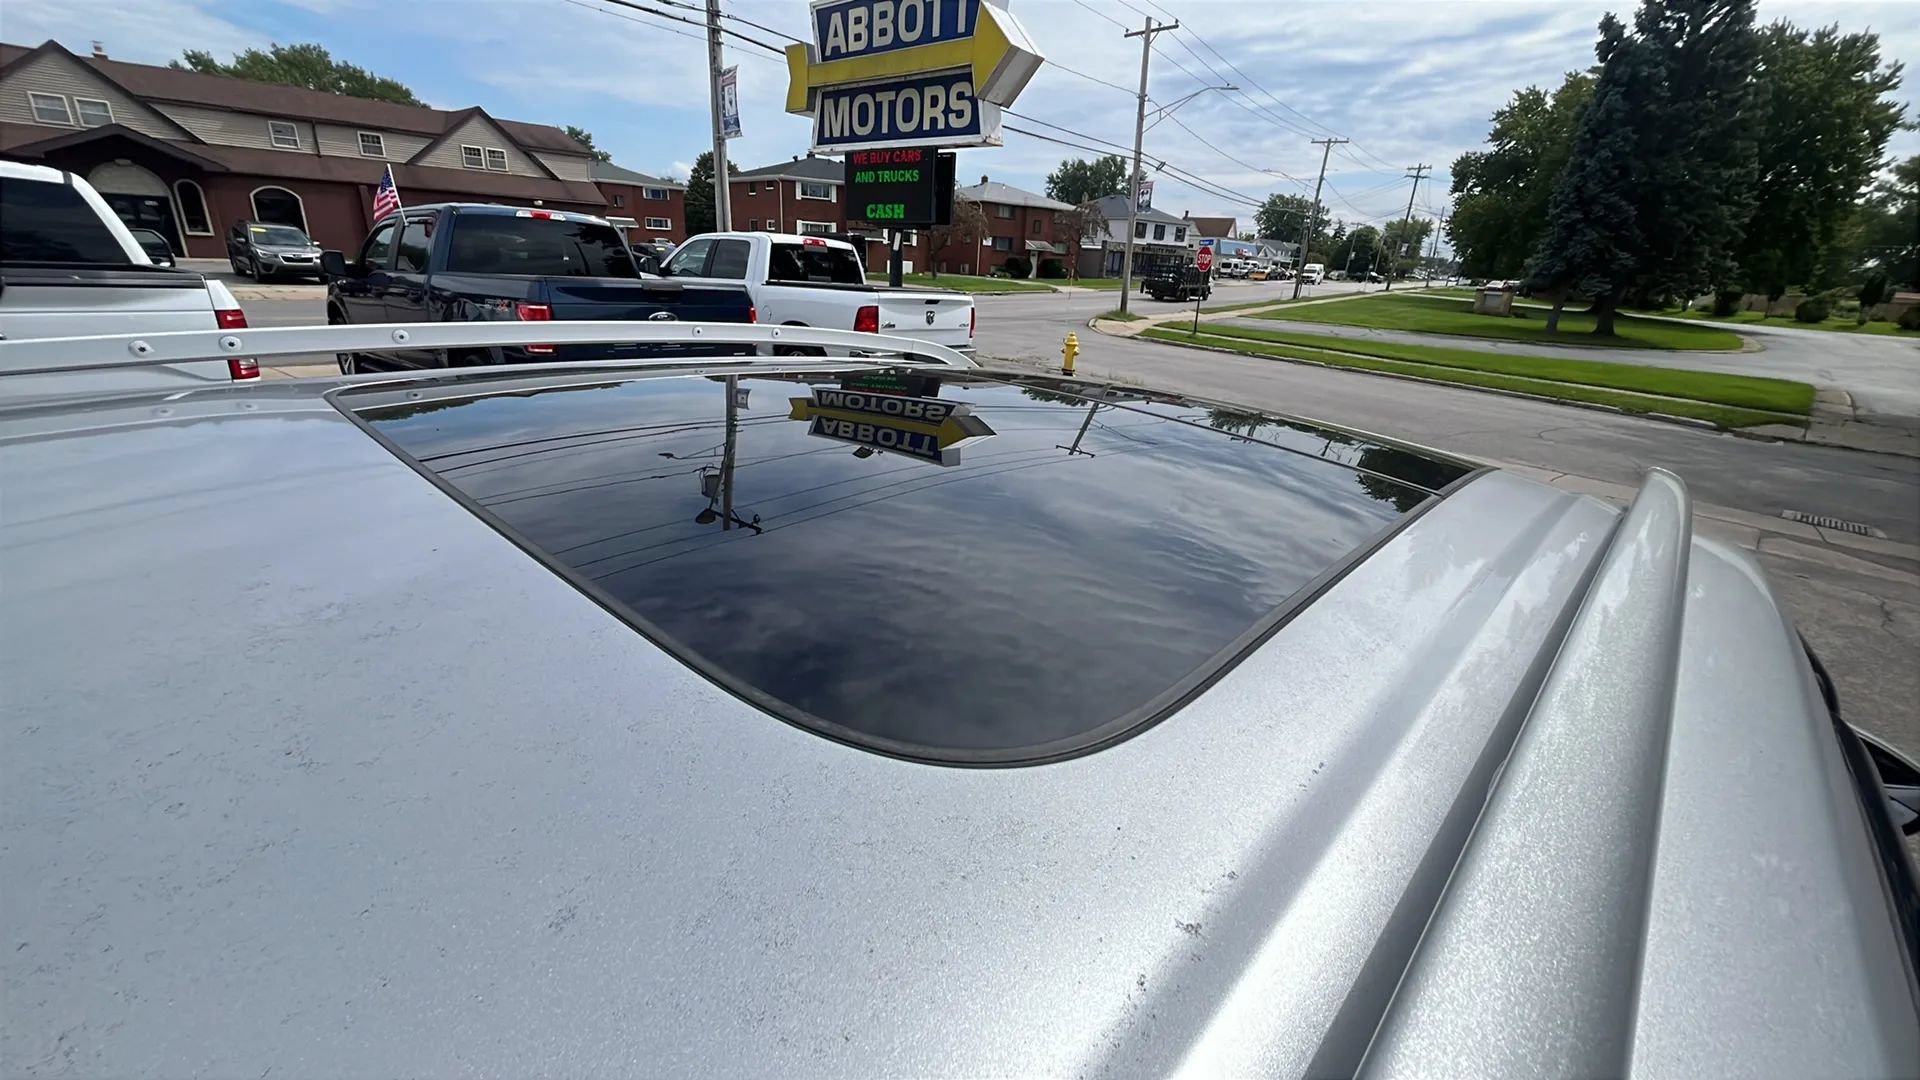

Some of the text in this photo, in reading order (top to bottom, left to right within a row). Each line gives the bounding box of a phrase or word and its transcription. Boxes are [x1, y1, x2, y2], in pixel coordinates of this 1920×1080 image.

[825, 0, 967, 56] ABBOTT
[823, 82, 973, 138] MOTORS
[853, 149, 922, 164] WE BUY CARS
[855, 169, 920, 183] AND TRUCKS
[866, 203, 905, 219] CASH
[1198, 254, 1211, 264] STOP
